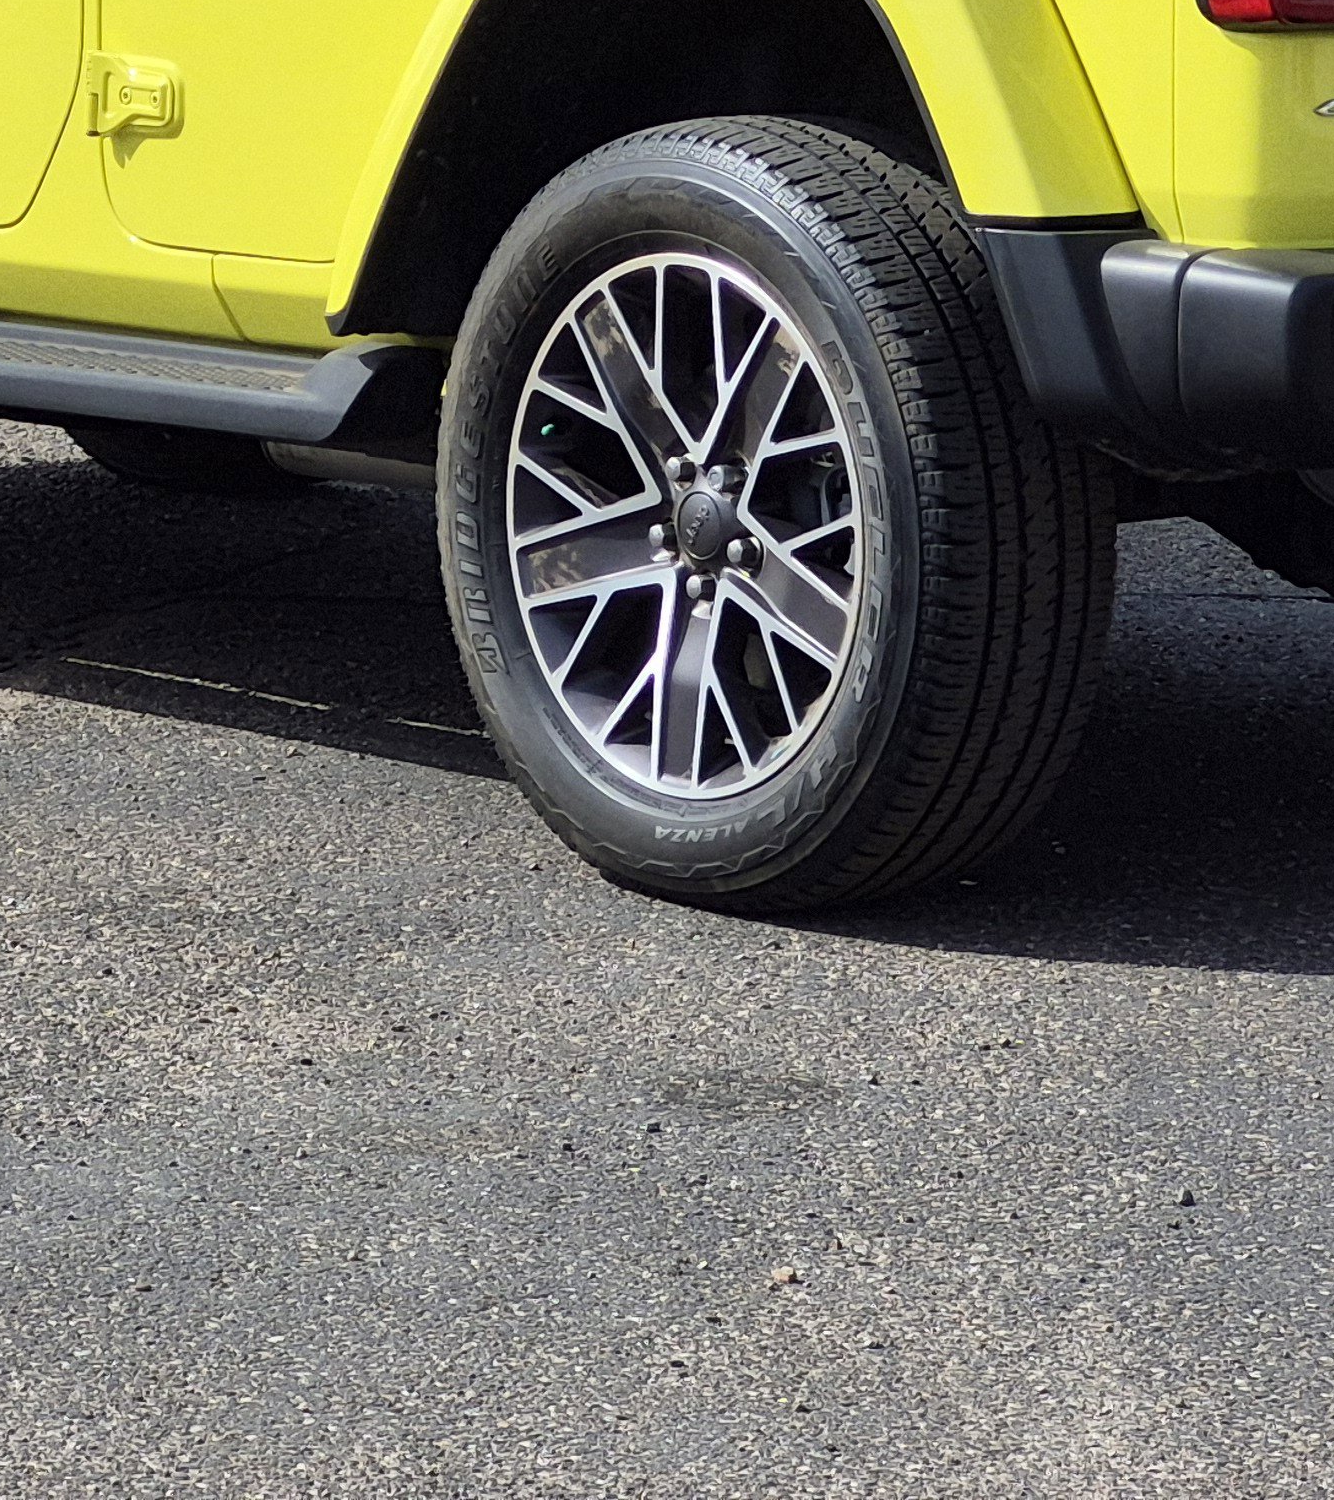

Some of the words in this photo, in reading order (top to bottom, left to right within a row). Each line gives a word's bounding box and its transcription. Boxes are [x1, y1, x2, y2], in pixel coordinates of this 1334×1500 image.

[454, 239, 561, 676] BRIDGESTONE
[818, 338, 889, 704] DUELER
[654, 816, 751, 844] ALENZA
